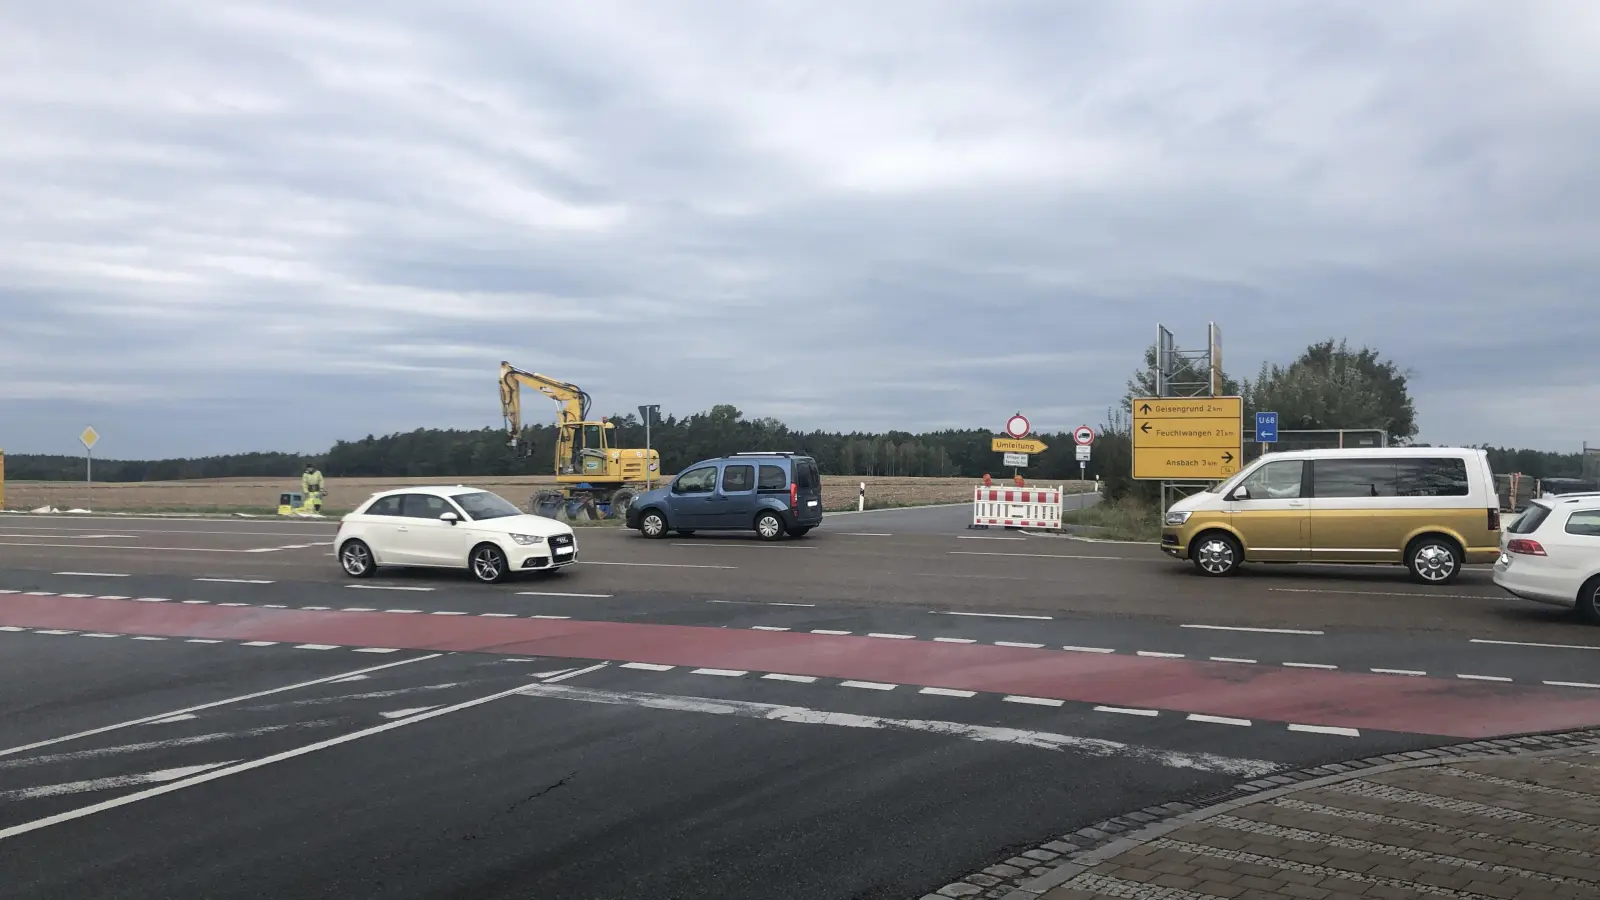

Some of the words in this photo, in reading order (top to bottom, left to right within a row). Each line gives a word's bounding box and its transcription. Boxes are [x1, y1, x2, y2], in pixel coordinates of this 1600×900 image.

[1155, 405, 1204, 413] Geisengrund
[1156, 430, 1212, 438] Feuchtwangen
[997, 442, 1034, 451] Umleitung
